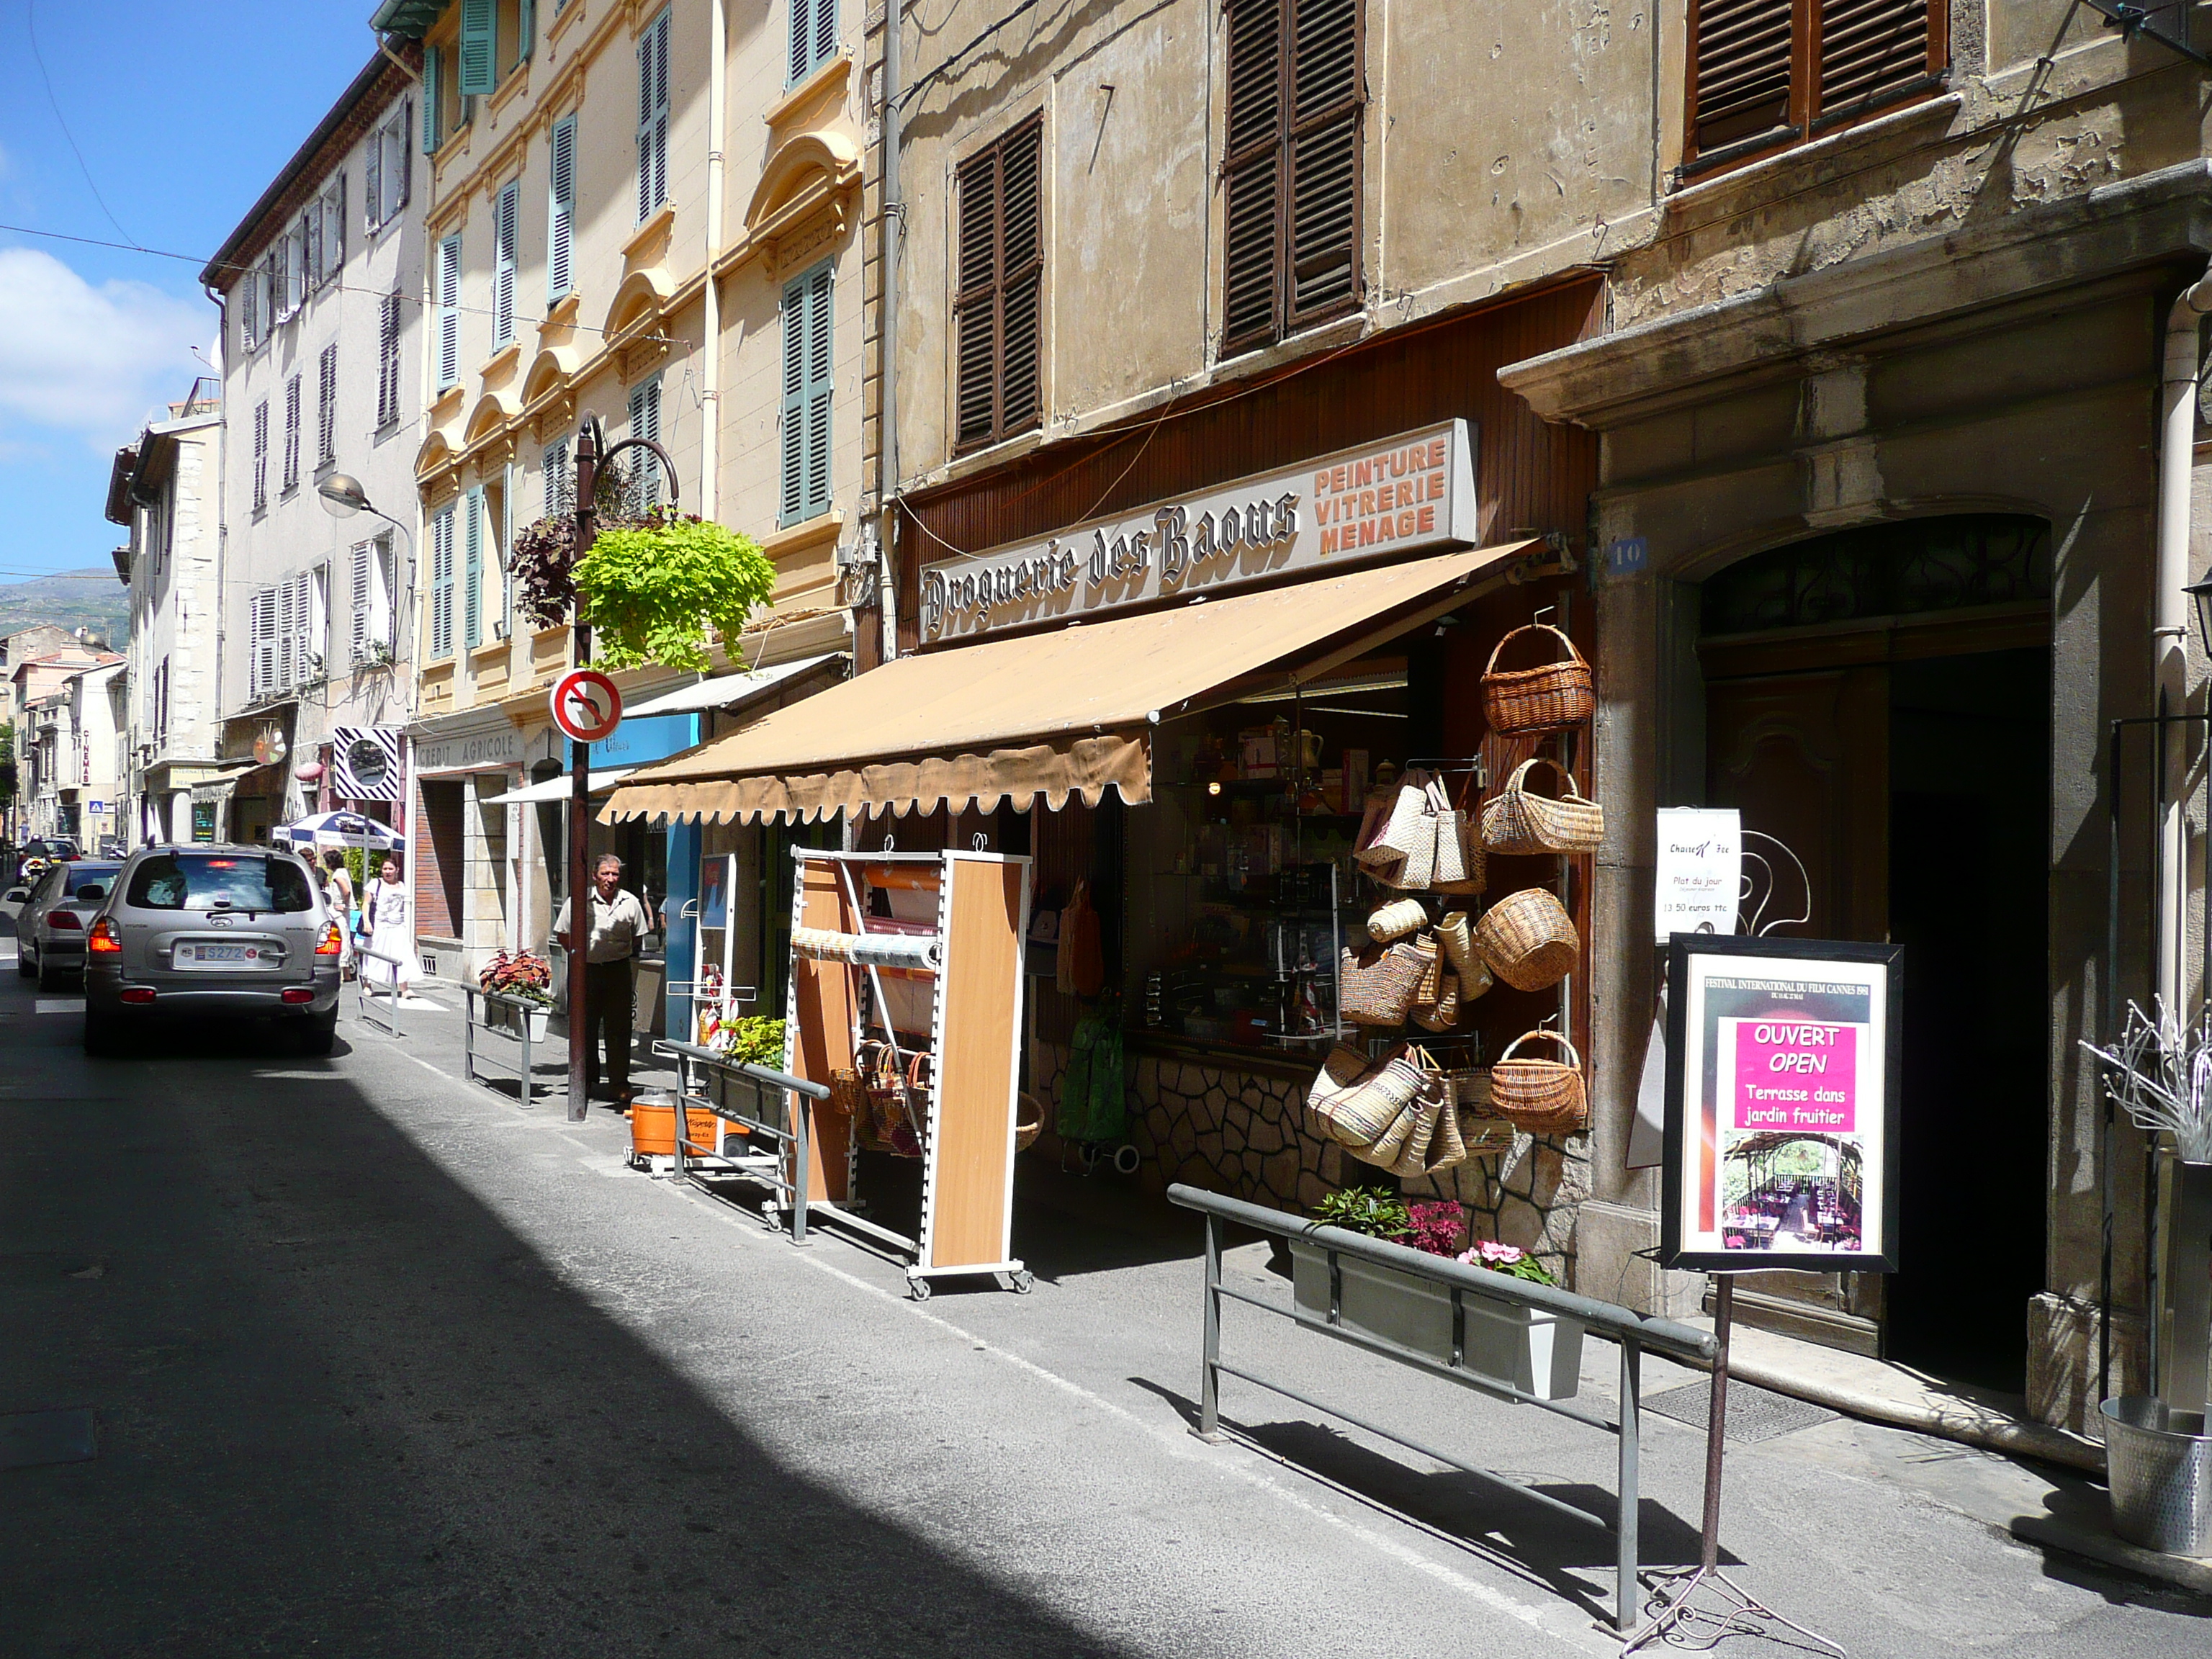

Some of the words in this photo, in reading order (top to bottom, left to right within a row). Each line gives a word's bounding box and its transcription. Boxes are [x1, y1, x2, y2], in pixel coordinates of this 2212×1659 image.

[1314, 437, 1446, 497] PEINTURE
[1314, 470, 1446, 526] VITRERIE
[1320, 505, 1435, 556] MENAGE
[922, 538, 1079, 633] Droguerie
[1087, 526, 1152, 589] des
[1154, 490, 1301, 585] Baous
[1617, 543, 1640, 565] 10
[419, 746, 451, 769] CREDIT
[462, 734, 513, 763] AGRICOLE
[1673, 876, 1689, 885] Plat
[1704, 877, 1722, 888] jour
[208, 947, 242, 958] S272
[1705, 978, 1737, 989] FESTIVAL
[1738, 979, 1796, 992] INTERNATIONAL
[1797, 983, 1807, 993] DU
[1808, 984, 1826, 994] FILM
[1827, 985, 1856, 995] CANNES
[1856, 986, 1869, 996] 1981
[1754, 1025, 1840, 1046] OUVERT
[1769, 1053, 1828, 1074] OPEN
[1745, 1084, 1809, 1102] Terrasse
[1814, 1086, 1846, 1103] dans
[1744, 1106, 1788, 1127] jardin
[1793, 1107, 1845, 1125] fruitier
